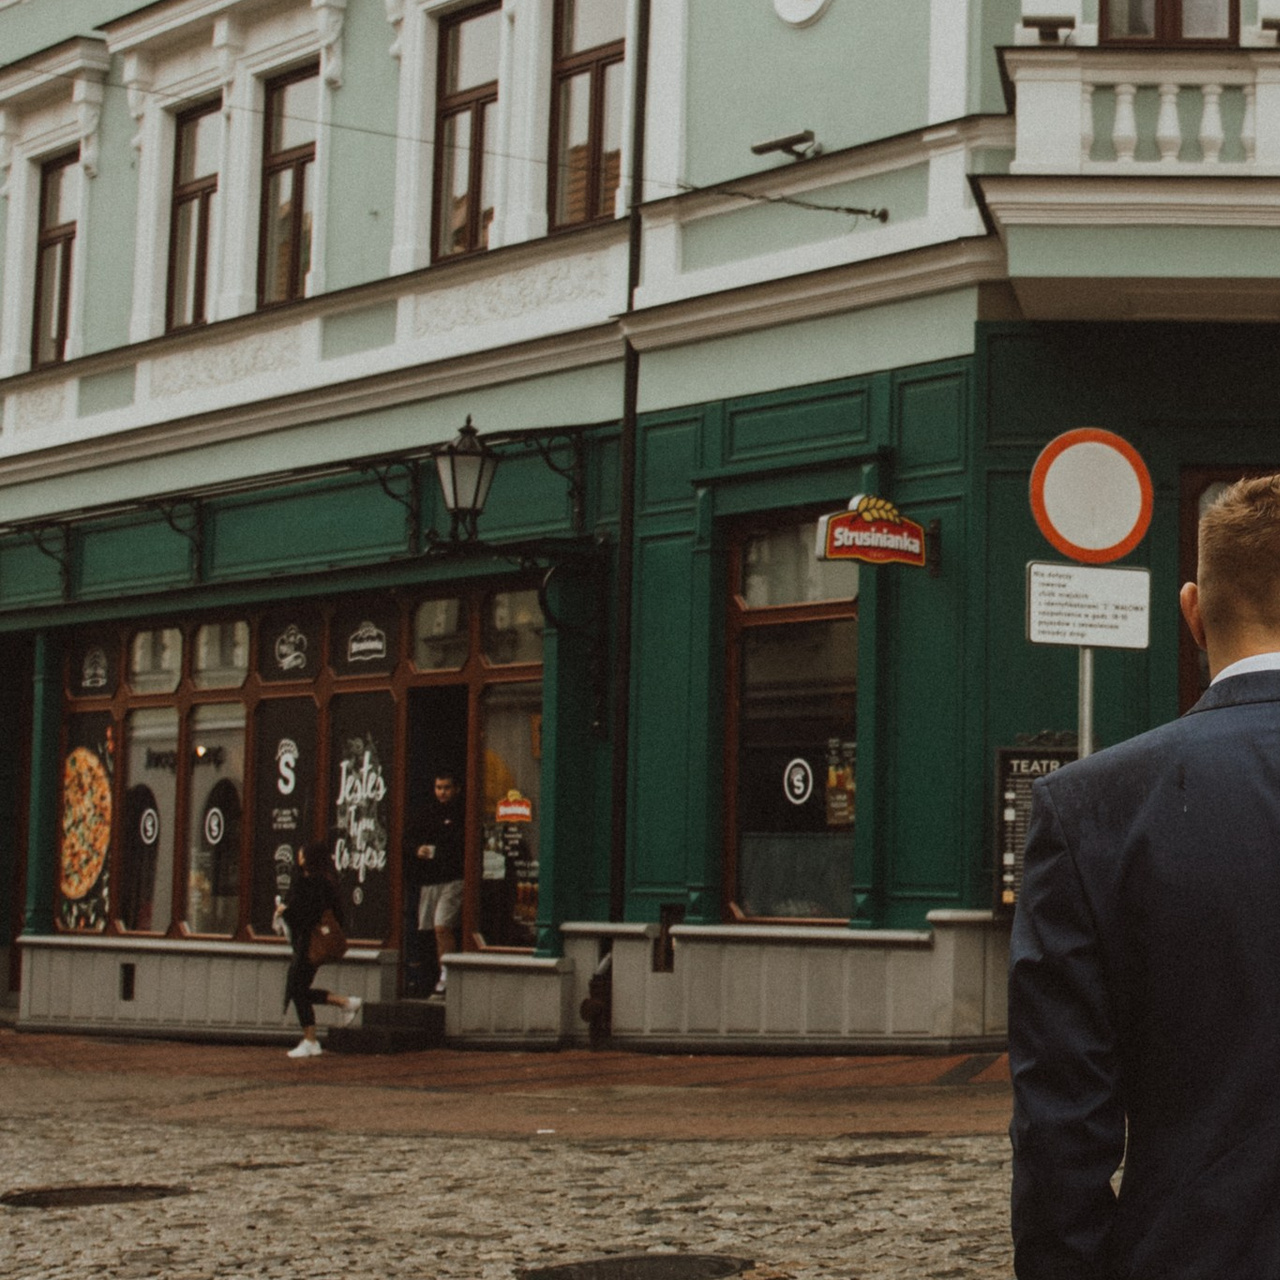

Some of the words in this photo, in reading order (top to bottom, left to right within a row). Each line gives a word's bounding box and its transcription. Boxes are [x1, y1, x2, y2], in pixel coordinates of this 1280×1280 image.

[833, 526, 921, 555] Strusinianka
[278, 753, 296, 795] S
[1010, 759, 1061, 773] TEATR
